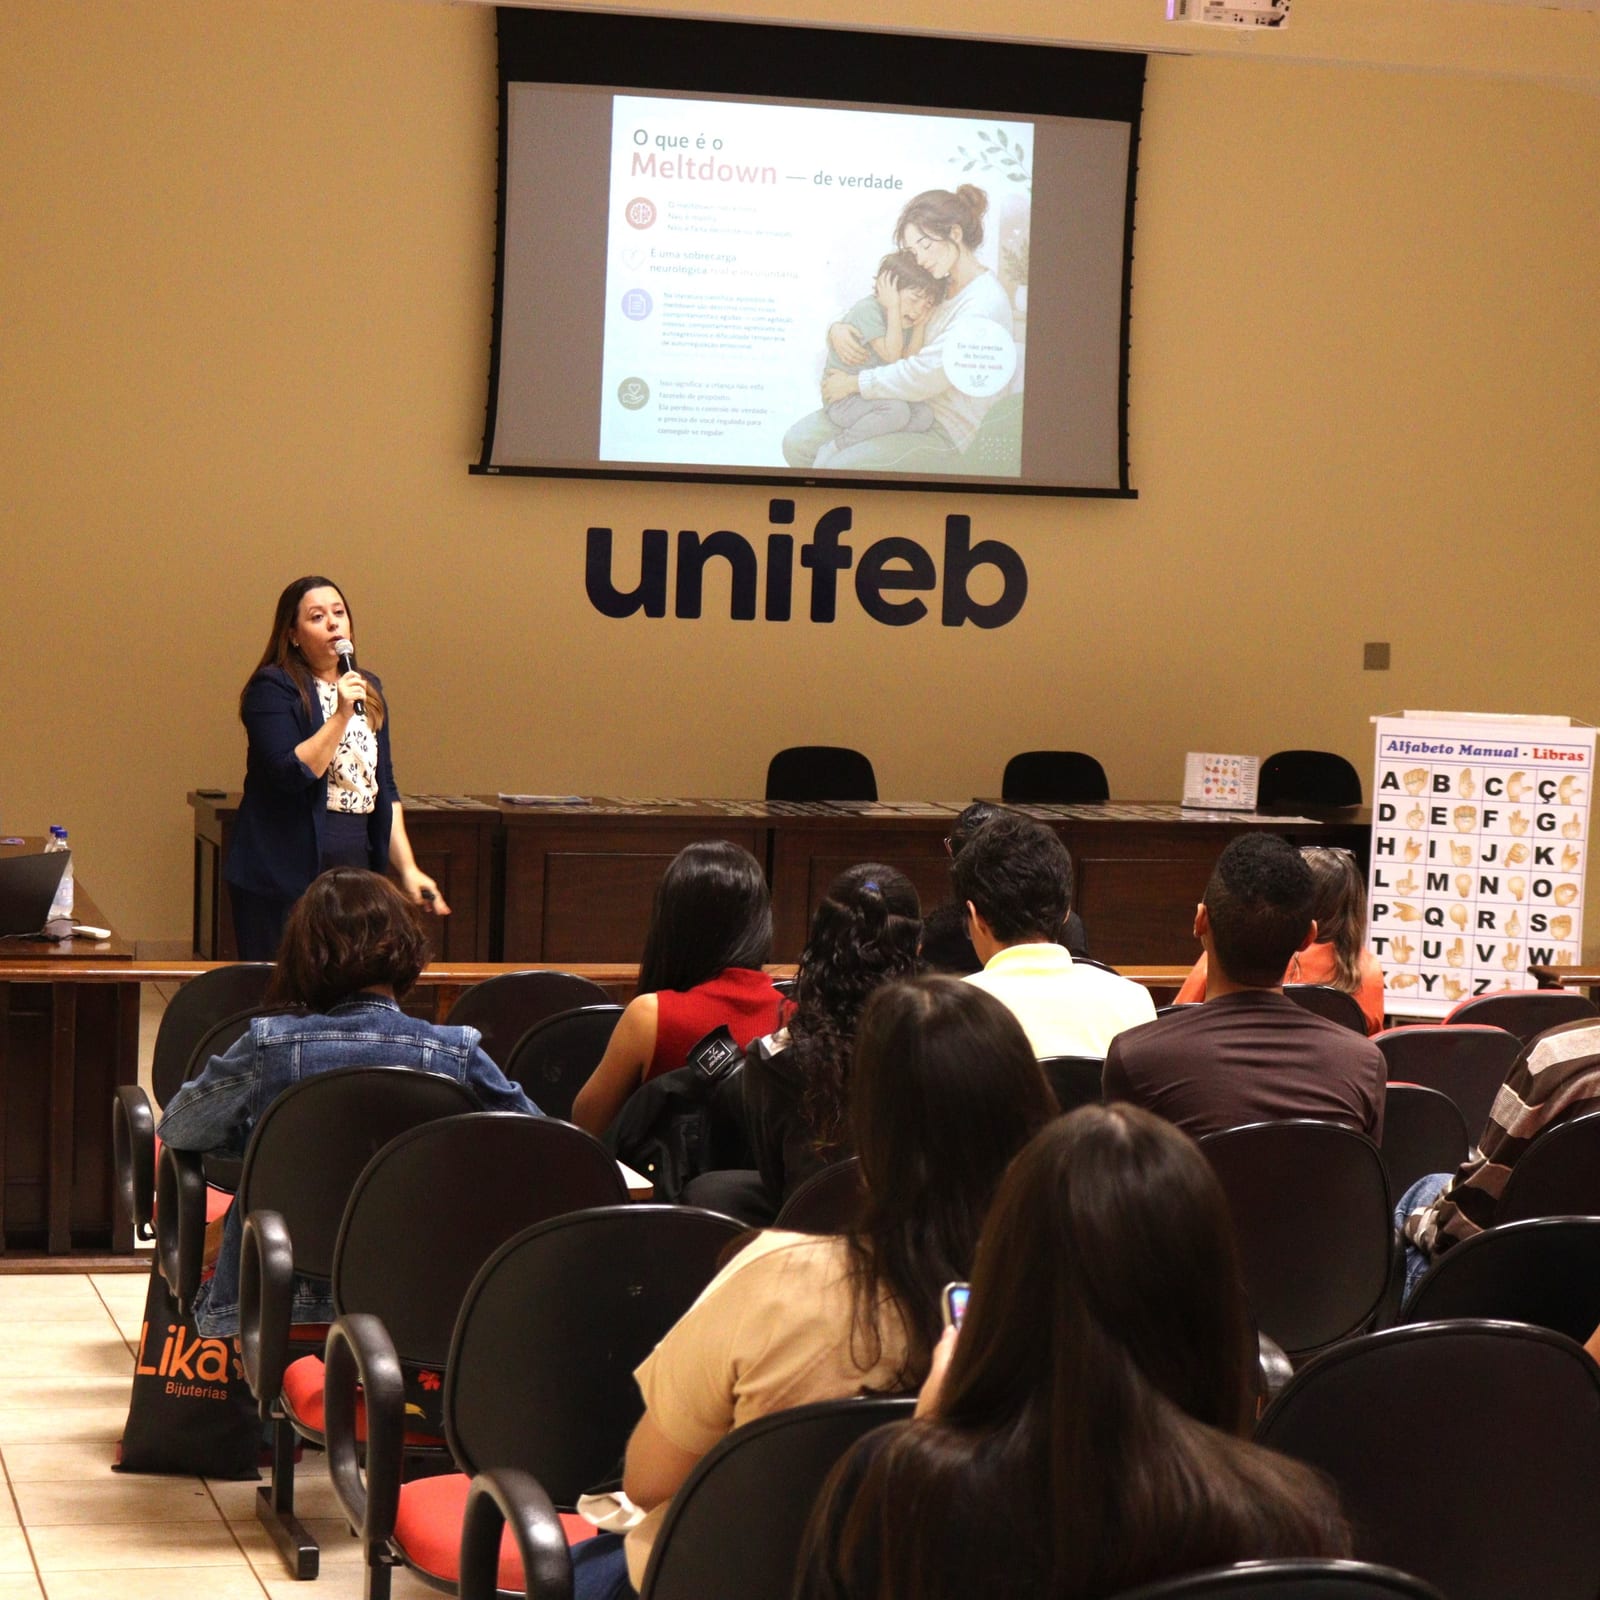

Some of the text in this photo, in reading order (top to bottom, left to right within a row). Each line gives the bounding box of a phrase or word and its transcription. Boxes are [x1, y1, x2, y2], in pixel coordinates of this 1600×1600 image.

[633, 129, 723, 151] O que é o
[631, 152, 777, 184] Meltdown
[813, 171, 833, 186] de
[838, 173, 903, 190] verdade
[683, 251, 737, 263] sobrecarga
[585, 498, 1028, 629] unifeb
[1386, 740, 1454, 755] Alfabeto
[1458, 744, 1519, 758] Manual
[1532, 748, 1584, 762] Libras
[1381, 772, 1556, 804] A B C Ç
[1379, 804, 1556, 831] D E F G
[1377, 837, 1554, 865] H I J K
[1375, 870, 1552, 897] L M N O
[1373, 904, 1547, 932] P Q R S
[1372, 937, 1554, 965] T U V W
[1421, 974, 1491, 995] Y Z
[136, 1321, 229, 1384] Lika
[165, 1381, 228, 1400] Bijuterias
